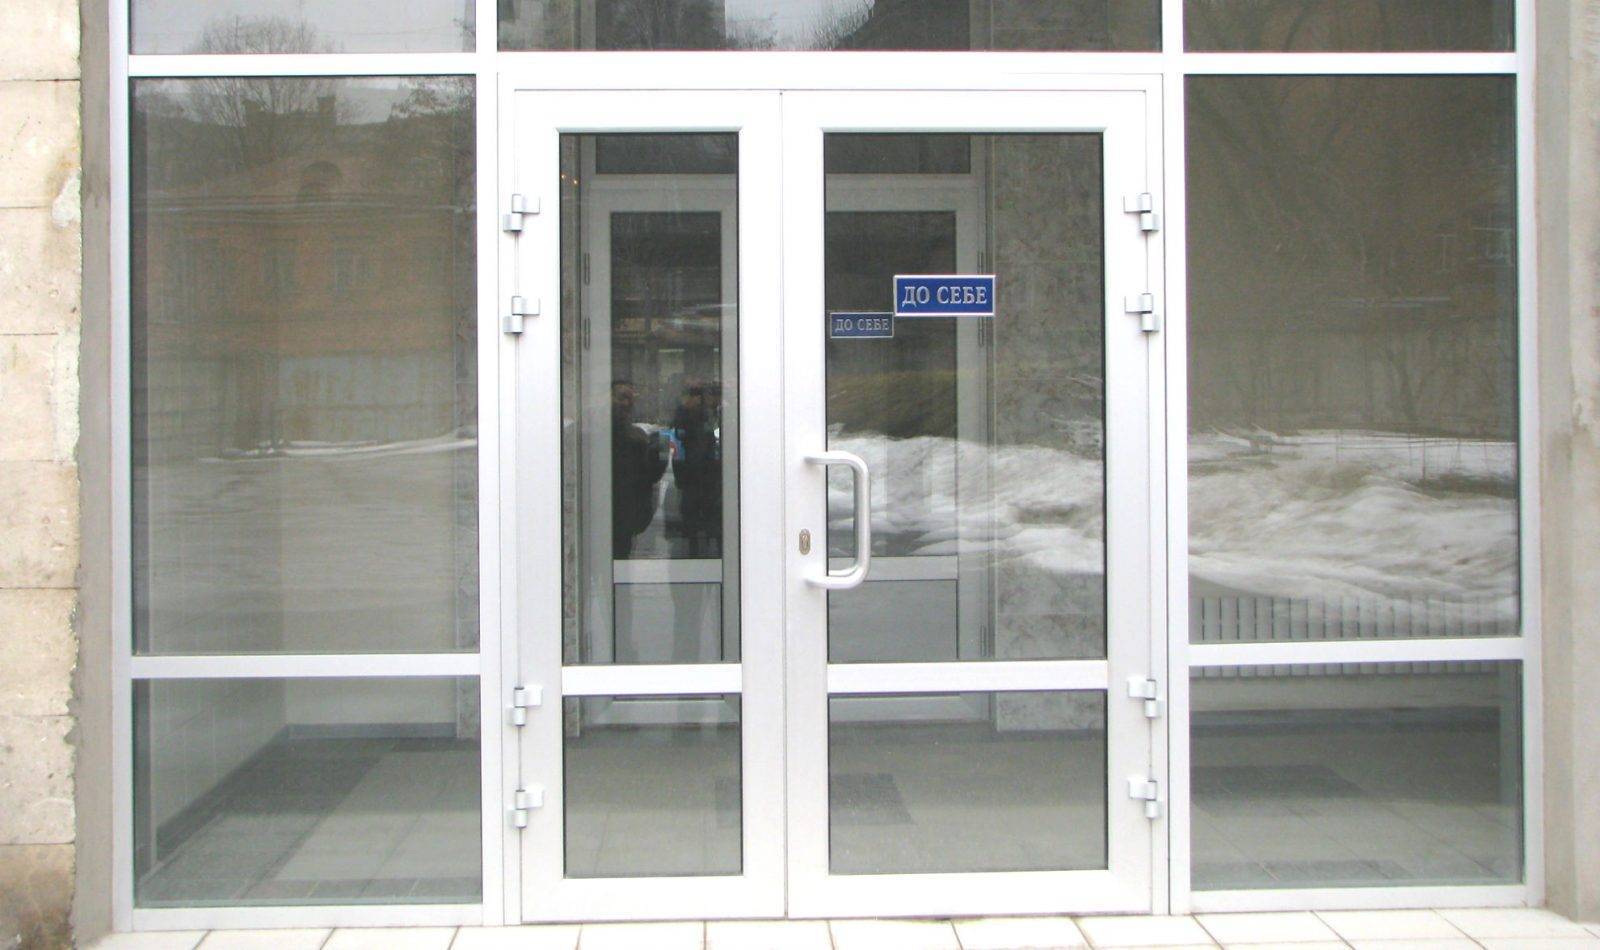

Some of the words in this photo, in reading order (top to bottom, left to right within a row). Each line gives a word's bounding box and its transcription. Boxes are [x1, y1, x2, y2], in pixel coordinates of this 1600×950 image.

[901, 286, 930, 308] ДО
[936, 286, 987, 304] СЕБЕ
[835, 319, 853, 332] ДО
[857, 318, 889, 331] СЕБЕ
